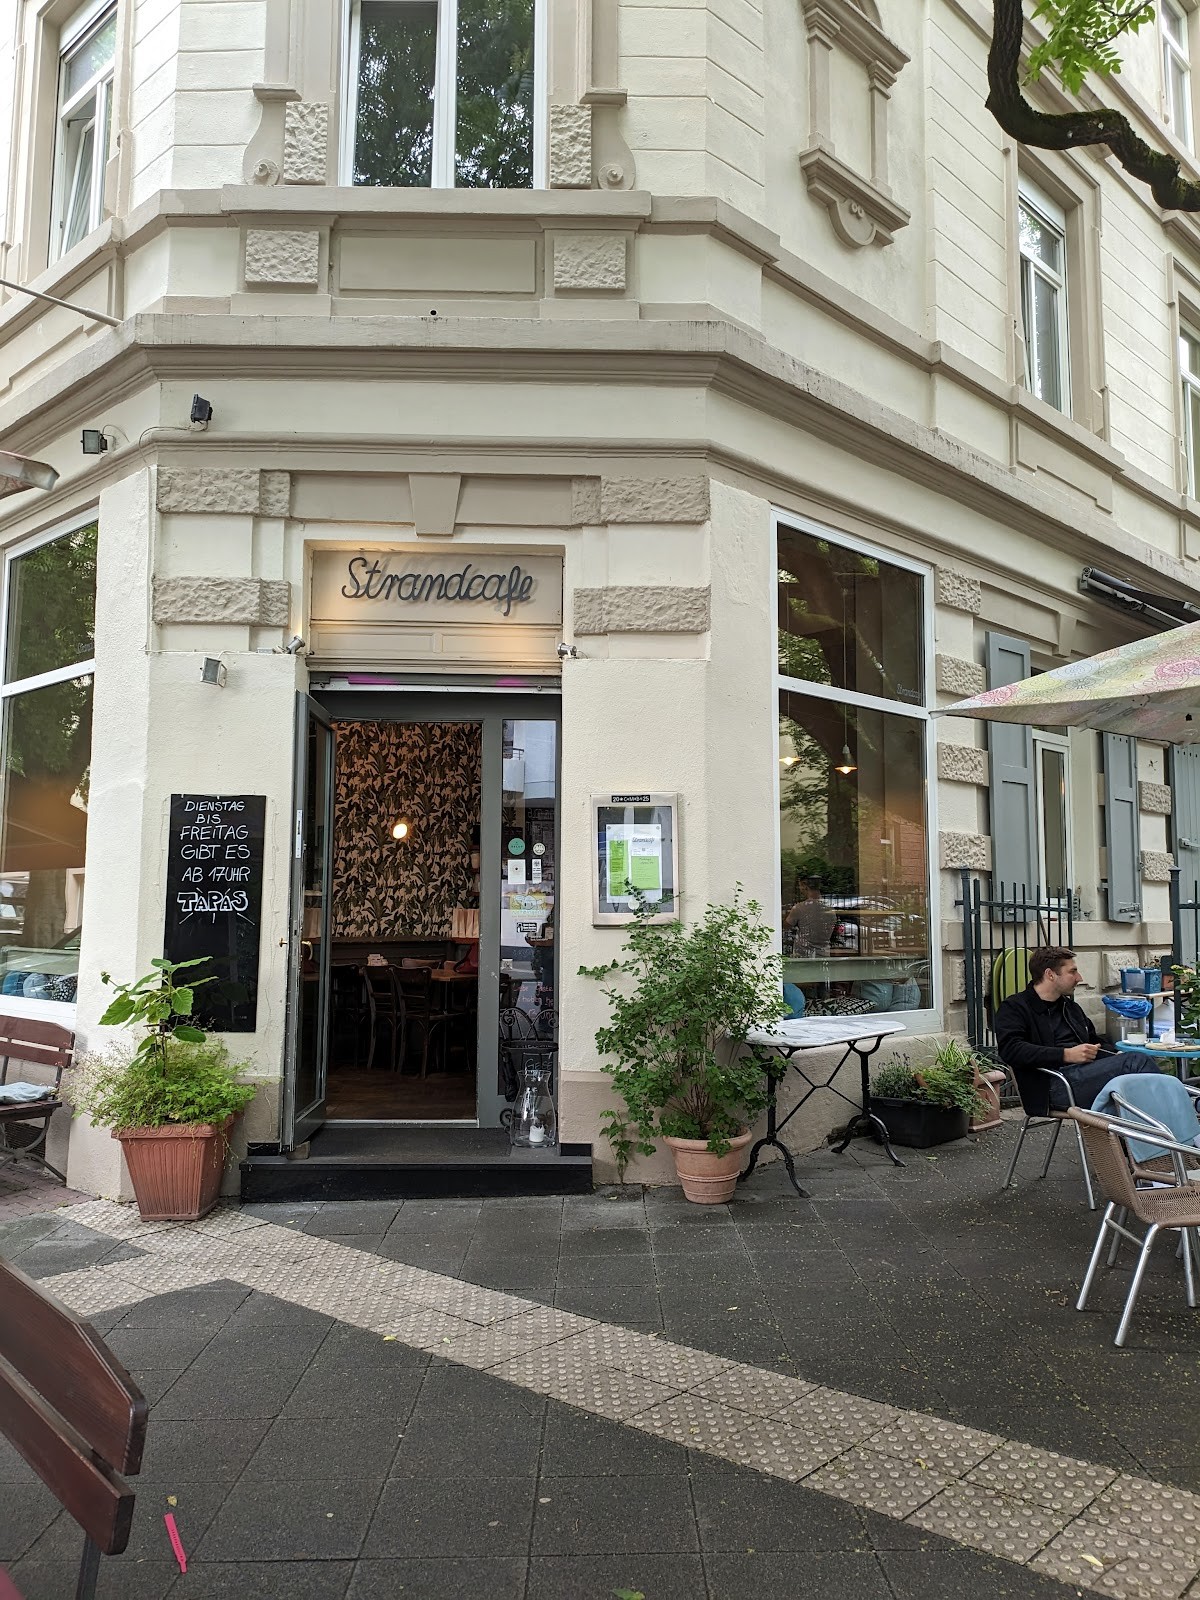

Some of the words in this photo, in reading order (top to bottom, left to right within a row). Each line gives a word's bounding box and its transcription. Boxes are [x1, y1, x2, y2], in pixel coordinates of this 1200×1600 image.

[341, 556, 534, 617] Strandcafe
[184, 801, 245, 812] DIENSTAG
[195, 813, 222, 824] BIS
[180, 825, 249, 840] FREITAG
[181, 844, 221, 860] GIBT
[225, 844, 251, 859] ES
[181, 866, 204, 882] AB
